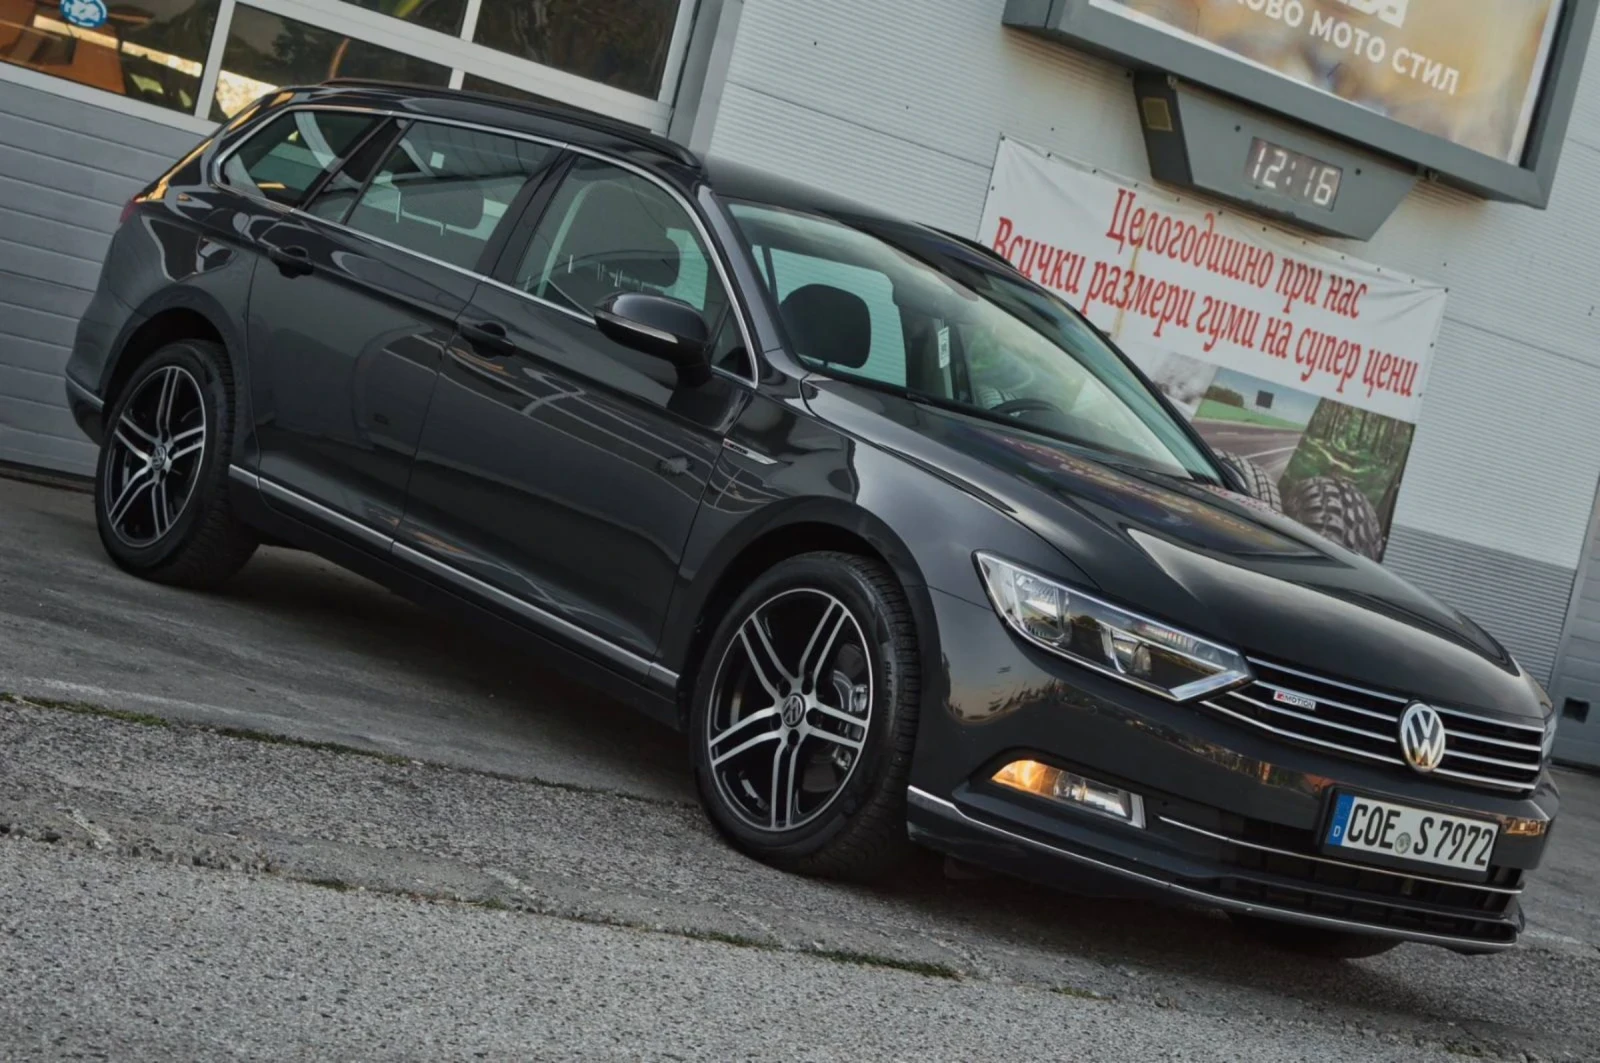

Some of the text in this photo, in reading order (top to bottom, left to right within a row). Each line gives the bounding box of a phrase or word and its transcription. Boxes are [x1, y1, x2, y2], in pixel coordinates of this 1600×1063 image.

[1237, 0, 1304, 28] ВО
[1309, 10, 1386, 63] МОТО
[1392, 47, 1459, 96] СТИЛ
[1253, 147, 1337, 206] 12:16
[1106, 188, 1367, 319] Целогодишно при нас
[993, 216, 1418, 398] Всички размери гуми на супер цени
[1347, 803, 1401, 849] COE
